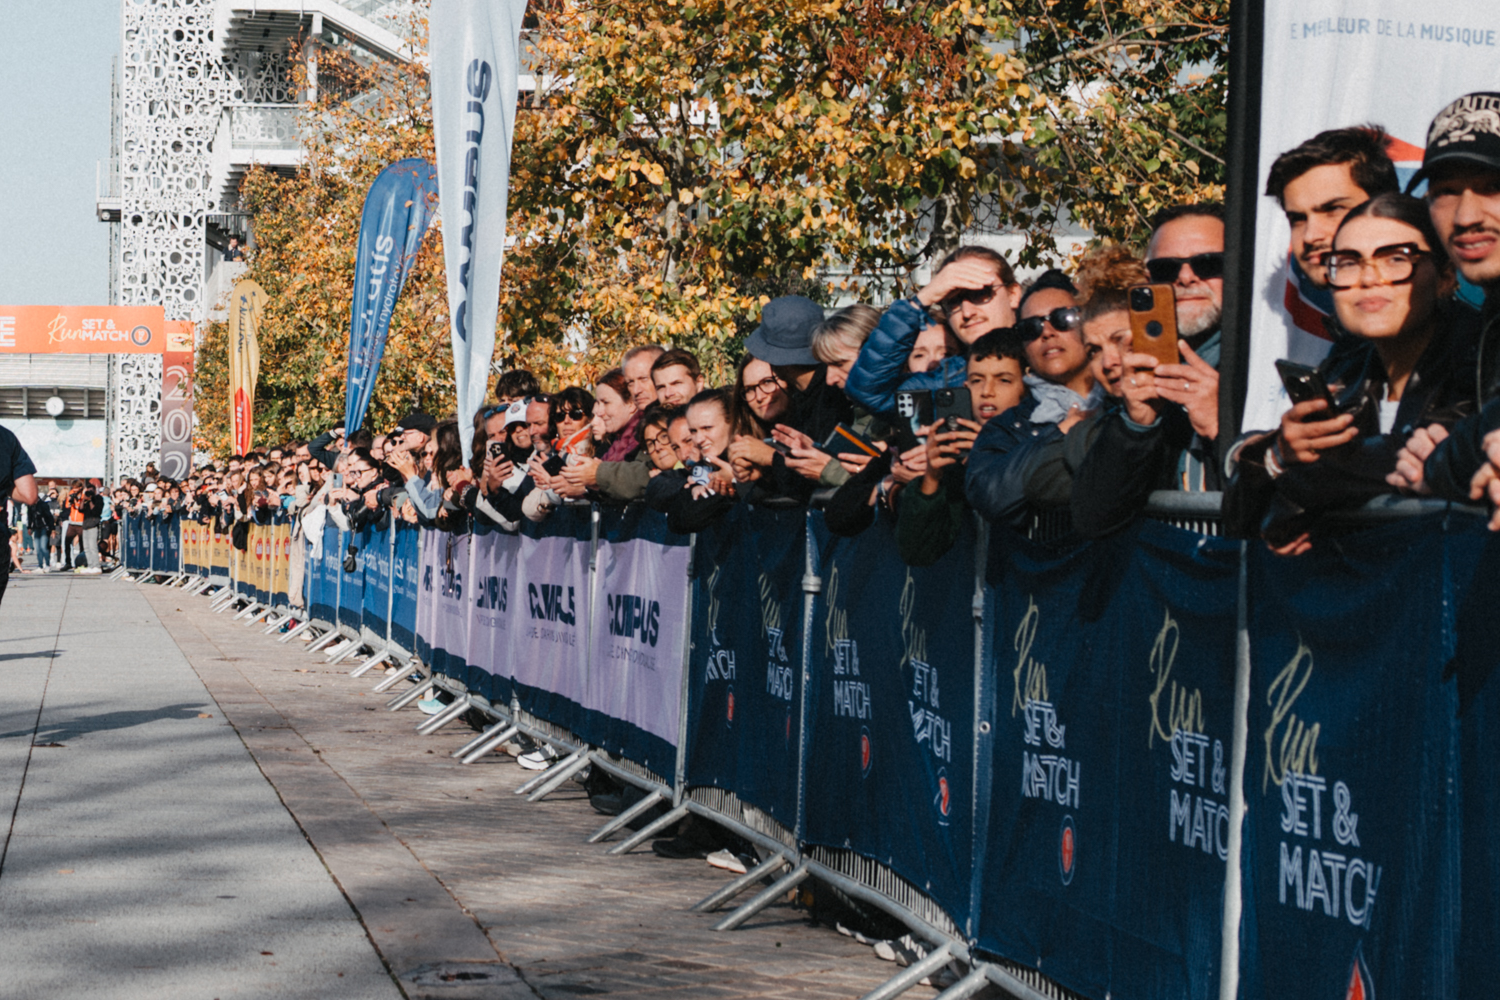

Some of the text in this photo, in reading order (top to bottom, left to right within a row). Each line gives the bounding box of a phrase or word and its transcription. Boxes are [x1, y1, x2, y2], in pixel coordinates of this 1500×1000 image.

[1377, 18, 1393, 37] DE
[1397, 20, 1416, 39] LA
[1420, 23, 1497, 47] MUSIQUE
[47, 313, 83, 345] Run
[81, 318, 116, 330] SET &
[81, 330, 129, 342] MATCH
[1012, 594, 1048, 718] Run
[1149, 606, 1204, 749] Run
[833, 680, 872, 719] MATCH
[1263, 640, 1321, 797] Run
[1022, 751, 1081, 809] MATCH
[1170, 728, 1227, 795] SET &
[1169, 789, 1231, 862] MATC
[1281, 769, 1361, 848] SET &
[1279, 842, 1383, 931] MATCH
